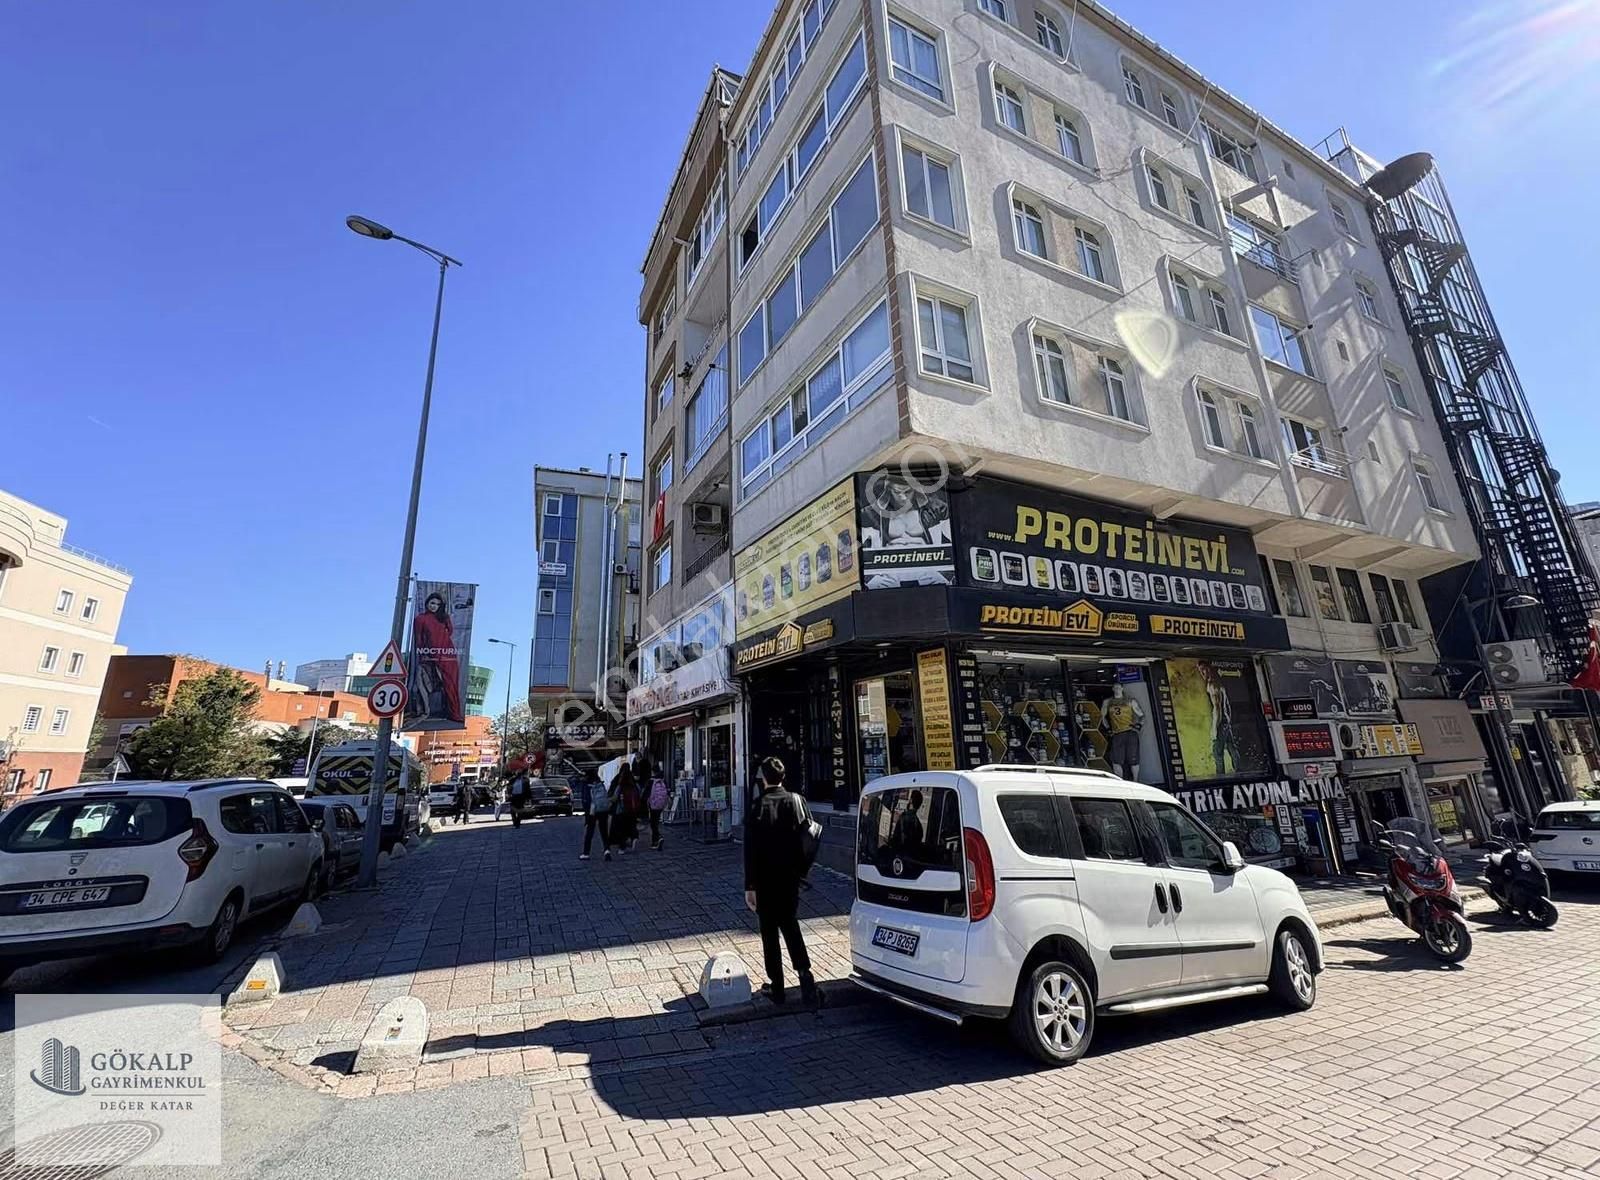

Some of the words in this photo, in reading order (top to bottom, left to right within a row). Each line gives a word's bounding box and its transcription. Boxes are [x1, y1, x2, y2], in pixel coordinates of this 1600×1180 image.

[981, 605, 1063, 627] PROTEİN
[1065, 610, 1091, 631] EVİ
[375, 690, 400, 708] 30
[322, 770, 353, 778] OKUL
[832, 747, 846, 788] SHOP
[28, 892, 44, 906] 34
[51, 890, 76, 904] CPE
[82, 887, 108, 901] 647
